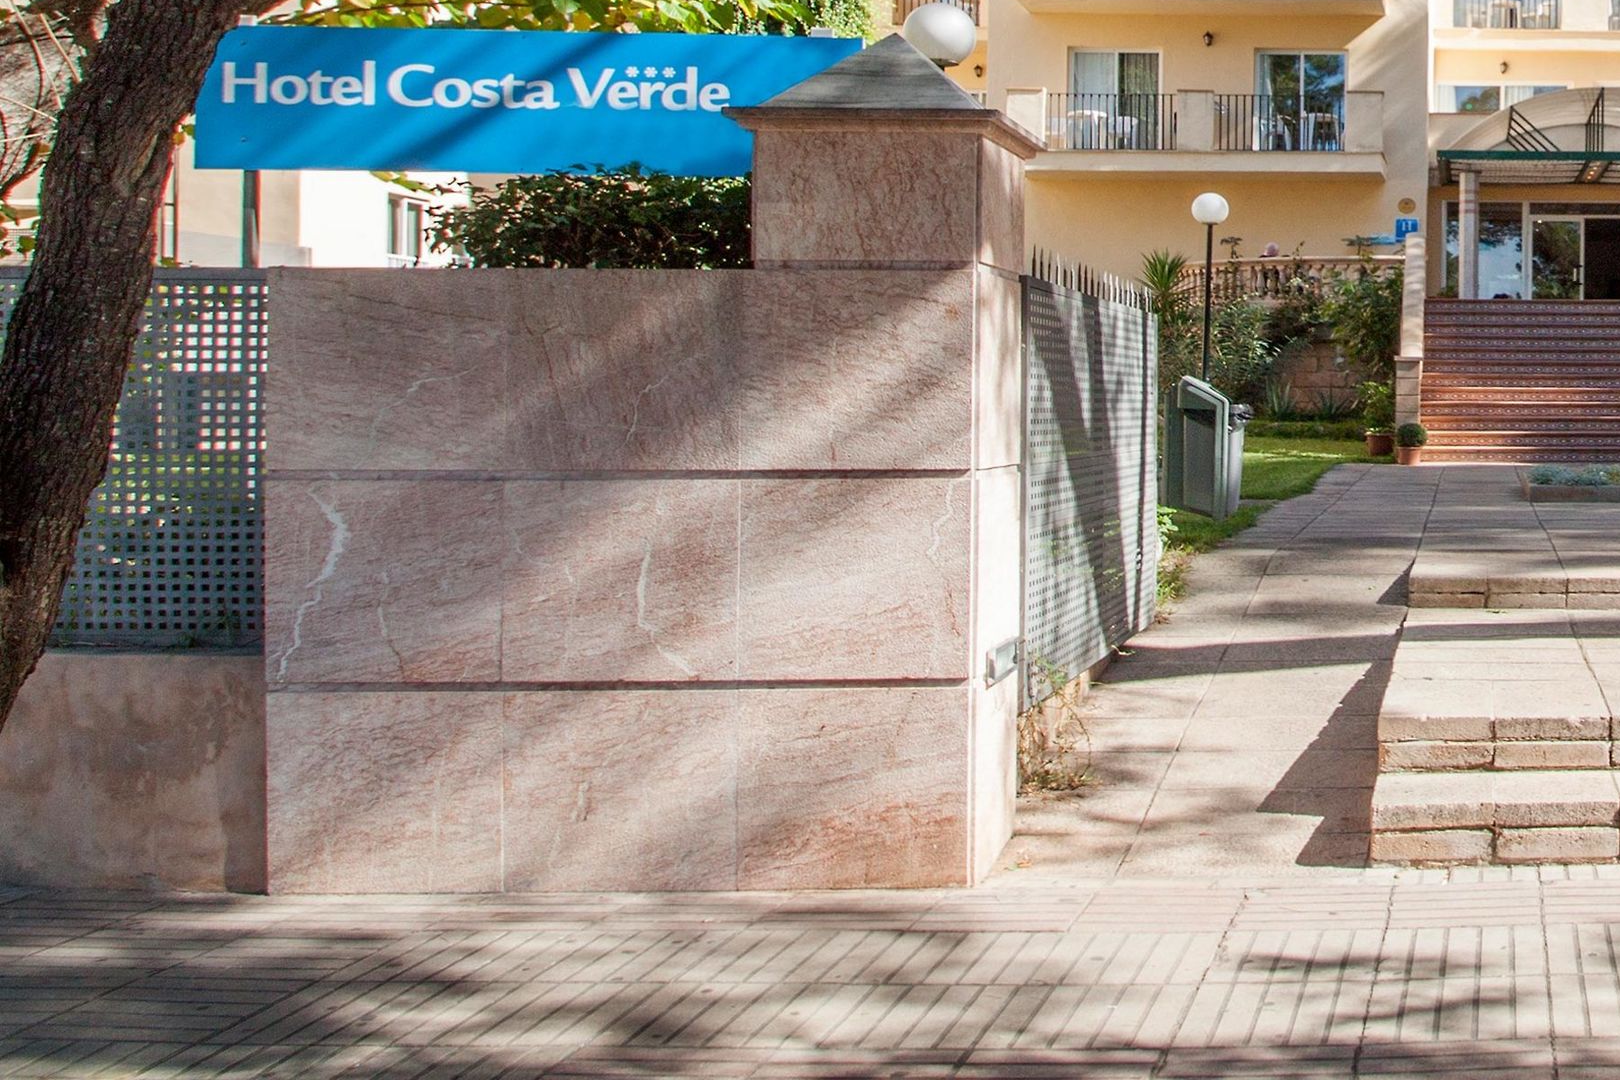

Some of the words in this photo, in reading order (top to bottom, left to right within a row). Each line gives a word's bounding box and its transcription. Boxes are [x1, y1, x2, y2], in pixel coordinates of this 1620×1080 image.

[221, 60, 376, 106] Hotel
[386, 63, 561, 110] Costa
[566, 66, 731, 112] Verde
